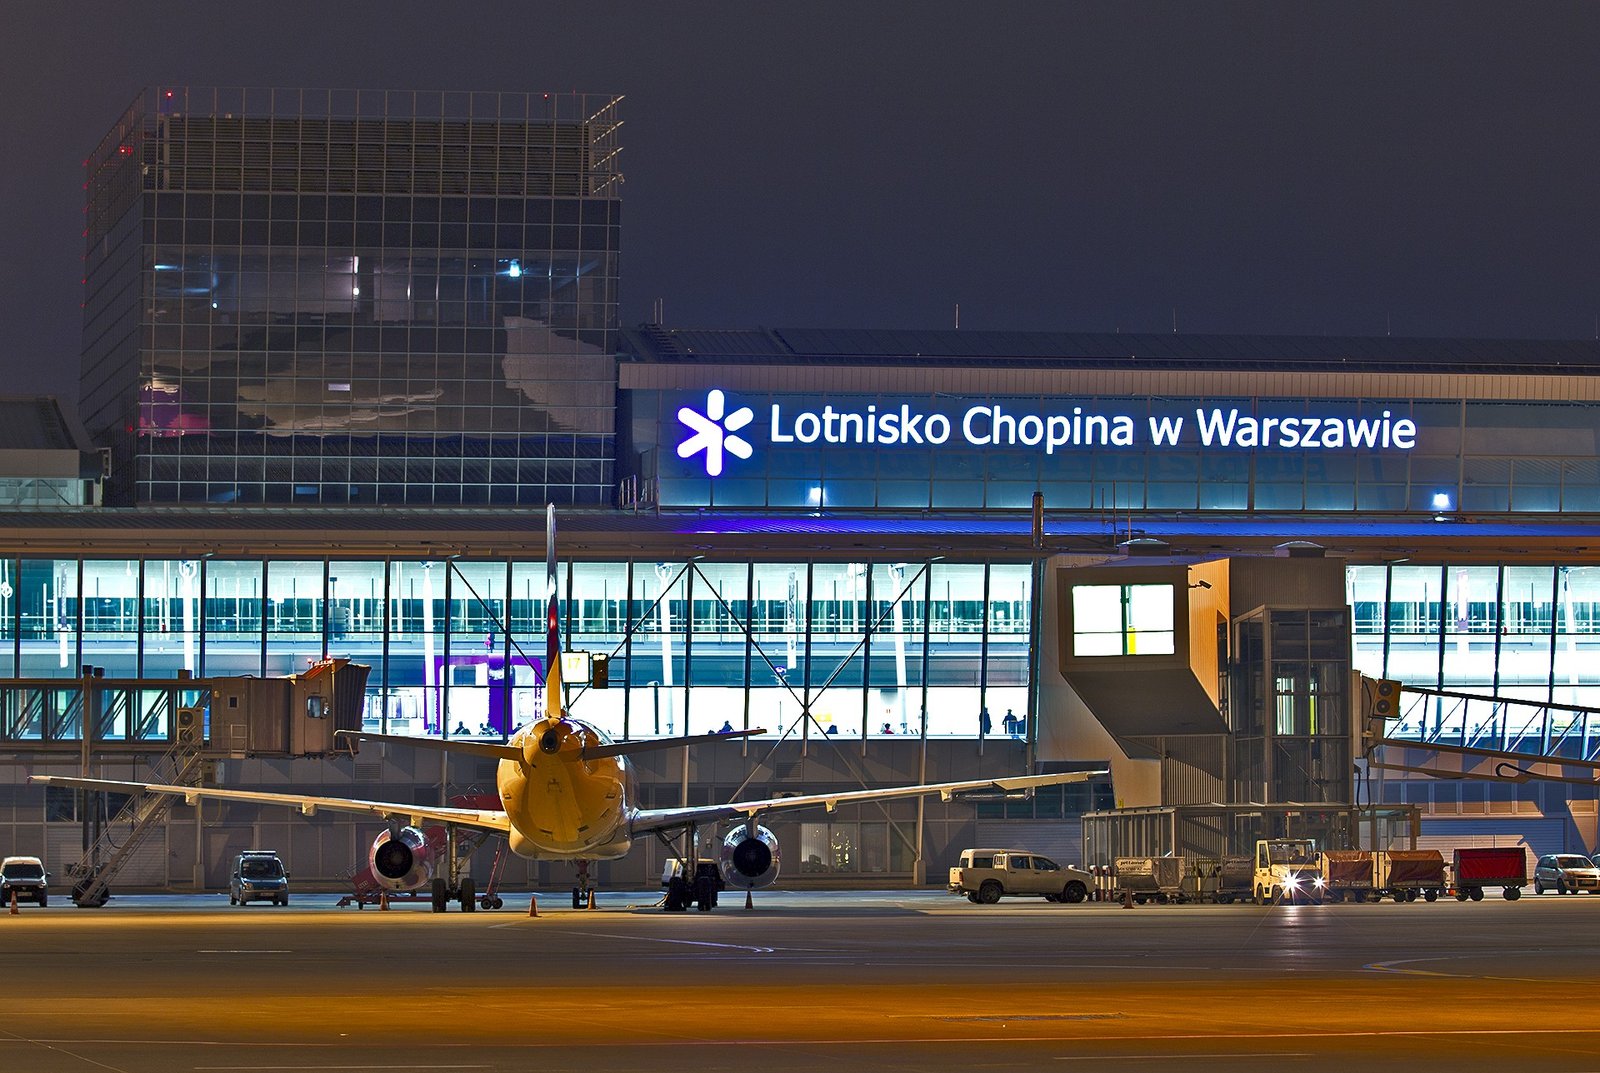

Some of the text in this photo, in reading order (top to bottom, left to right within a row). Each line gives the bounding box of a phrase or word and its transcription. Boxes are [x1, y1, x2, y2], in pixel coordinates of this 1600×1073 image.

[771, 404, 1416, 455] Lotnisko Chopina w Warszawie
[568, 657, 581, 670] 17
